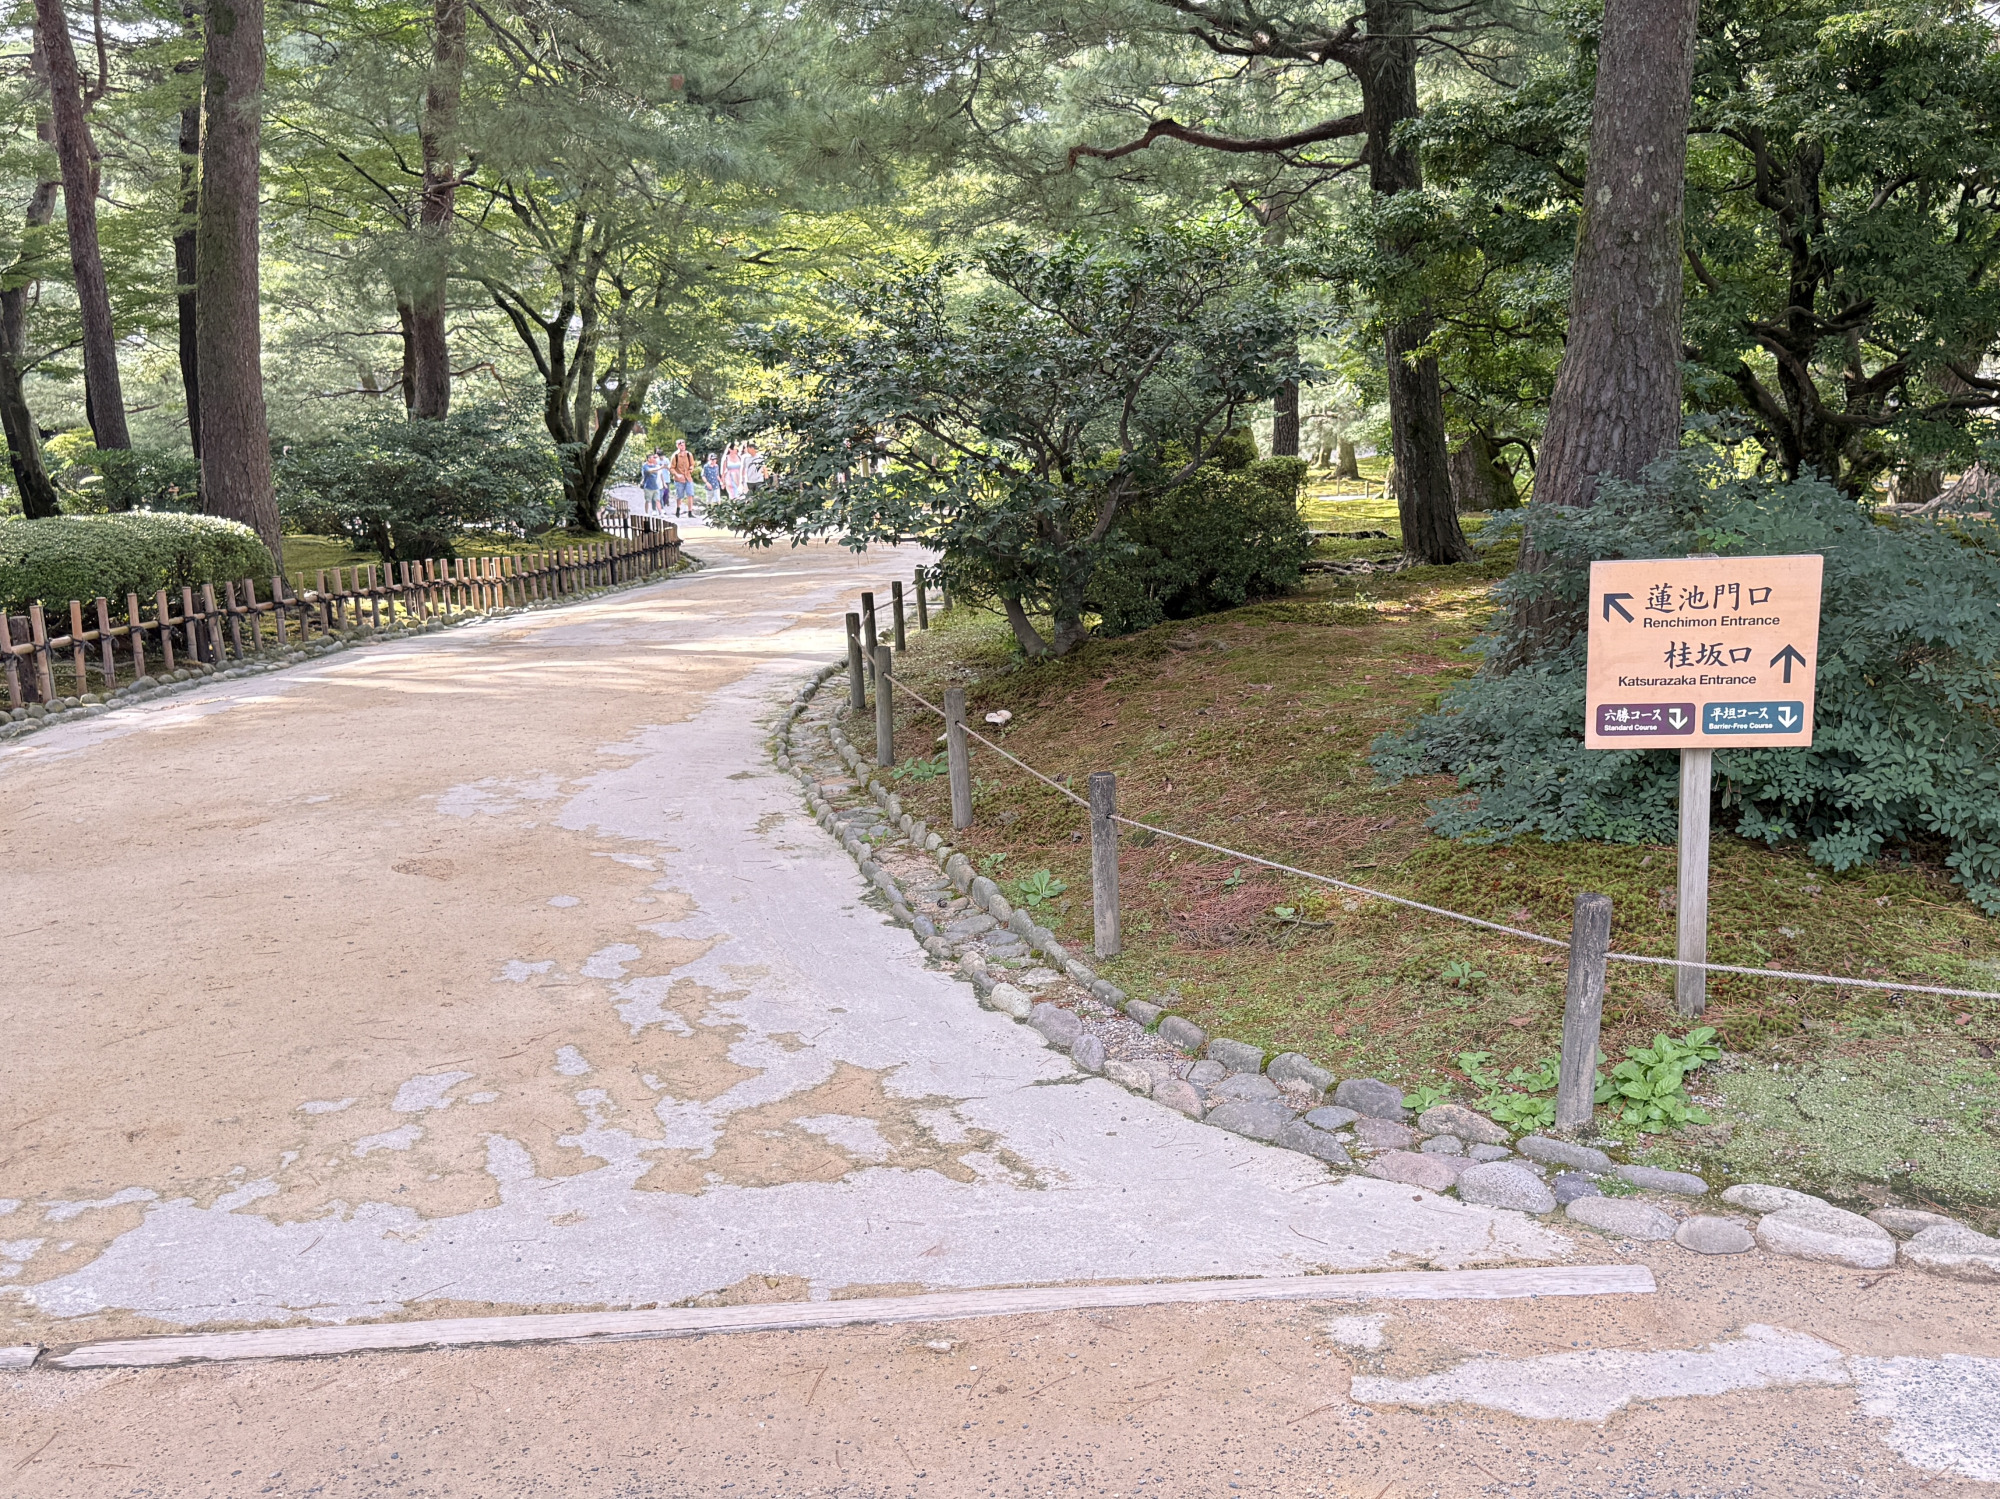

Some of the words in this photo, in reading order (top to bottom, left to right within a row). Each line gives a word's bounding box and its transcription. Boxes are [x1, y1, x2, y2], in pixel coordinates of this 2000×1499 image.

[1645, 582, 1773, 613] 蓮池門口
[1643, 617, 1717, 628] Renchimon
[1721, 616, 1780, 626] Entrance
[1664, 641, 1752, 669] 桂坂口
[1618, 675, 1696, 687] Katsurazaka
[1699, 675, 1756, 685] Entrance
[1604, 708, 1662, 723] 六勝コース
[1710, 706, 1769, 722] 平坦コース
